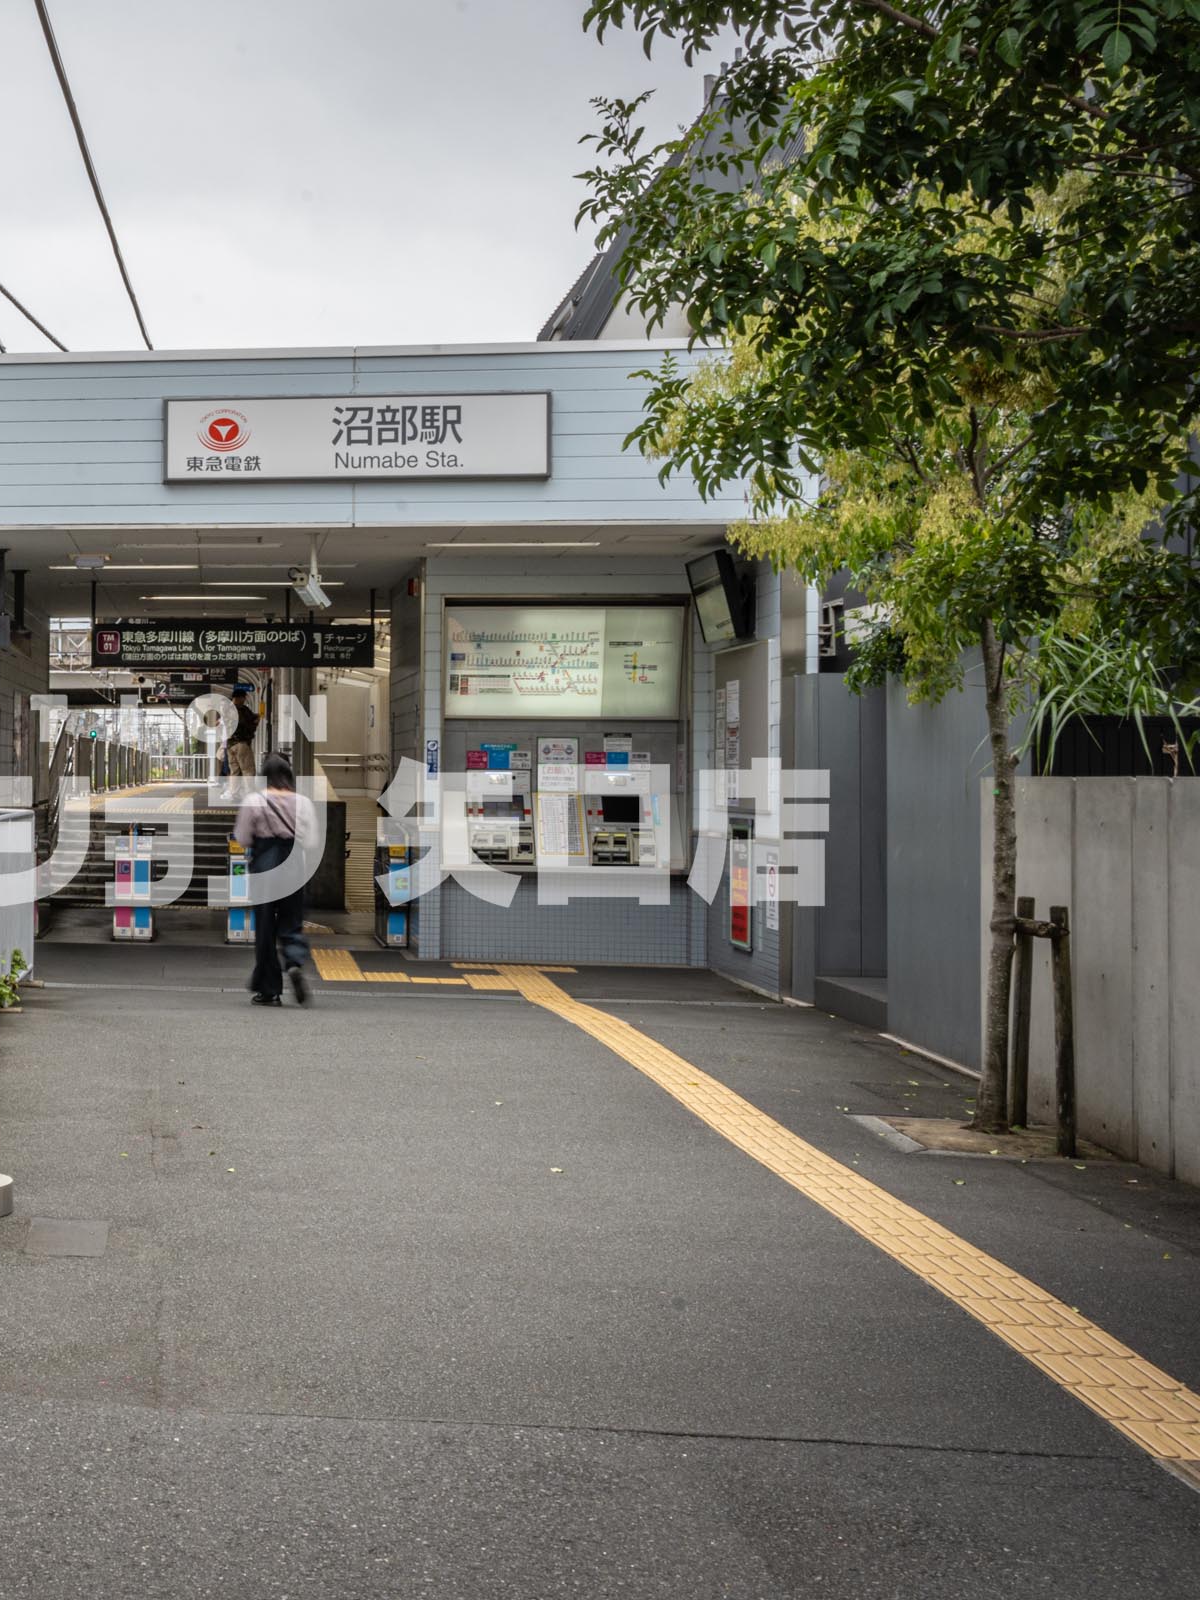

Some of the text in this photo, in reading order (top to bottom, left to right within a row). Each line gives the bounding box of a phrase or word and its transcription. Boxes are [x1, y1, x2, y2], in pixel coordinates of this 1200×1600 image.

[331, 405, 463, 447] 沼部駅
[186, 455, 262, 473] 東急電鉄
[334, 450, 465, 470] Numabe Sta.
[122, 630, 194, 643] 東急多摩川線
[324, 632, 367, 645] チャージ
[103, 642, 113, 651] 01
[143, 644, 178, 653] Tamagawa
[178, 644, 193, 652] Line
[205, 644, 256, 653] for Tamagawa
[323, 644, 355, 653] Recharge
[159, 683, 167, 694] 2
